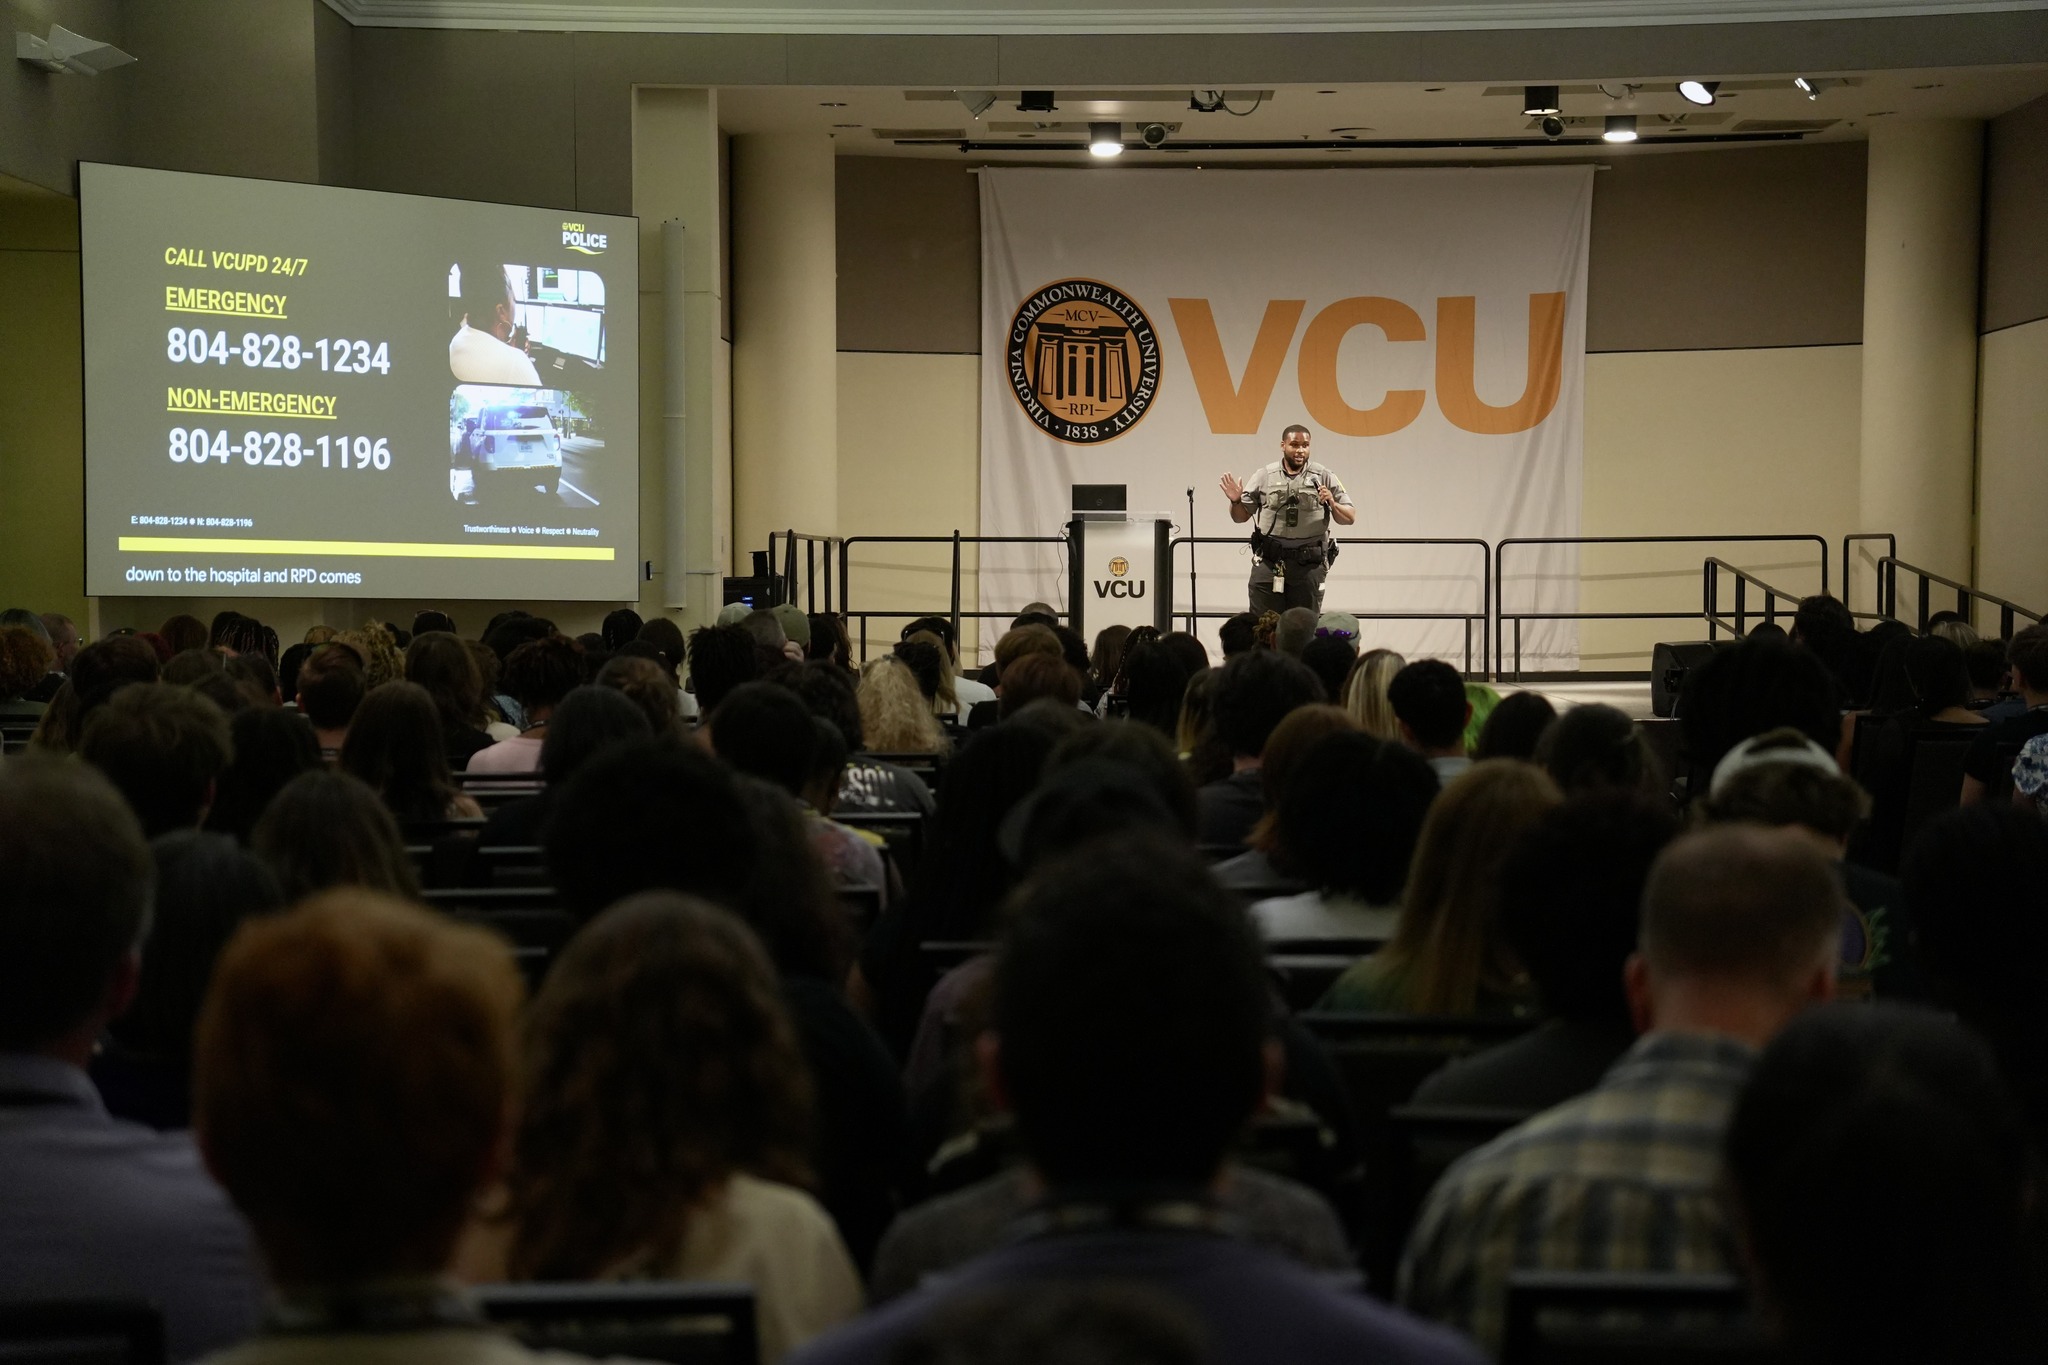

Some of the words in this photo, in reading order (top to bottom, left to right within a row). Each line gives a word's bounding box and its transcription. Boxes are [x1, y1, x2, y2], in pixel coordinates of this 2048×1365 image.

[562, 231, 607, 248] POLICE
[568, 223, 584, 232] VCU
[165, 247, 207, 267] CALL
[212, 251, 268, 273] VCUPD
[271, 256, 308, 277] 24/7
[165, 286, 287, 317] EMERGENCY
[1013, 284, 1143, 343] COMMONWEALTH
[1065, 309, 1099, 323] MCV
[167, 327, 391, 375] 804-828-1234
[1167, 291, 1566, 437] VCU
[1011, 348, 1051, 429] VIRGINIA
[1114, 328, 1157, 432] UNIVERSITY
[167, 387, 337, 417] NON-EMERGENCY
[1069, 403, 1094, 416] RPI
[1064, 424, 1099, 439] 1838
[168, 427, 391, 470] 804-828-1196
[139, 516, 188, 526] 804-828-1234
[206, 518, 253, 527] 804-828-1196
[463, 524, 510, 534] Trustworthiness
[518, 526, 534, 534] Voice
[542, 527, 565, 536] Respect
[572, 528, 599, 537] Neutrality
[126, 566, 164, 582] down
[167, 567, 182, 582] to
[184, 566, 207, 582] the
[210, 567, 261, 586] hospital
[263, 568, 288, 583] and
[290, 568, 317, 583] RPD
[319, 572, 361, 584] comes
[1093, 580, 1145, 599] VCU
